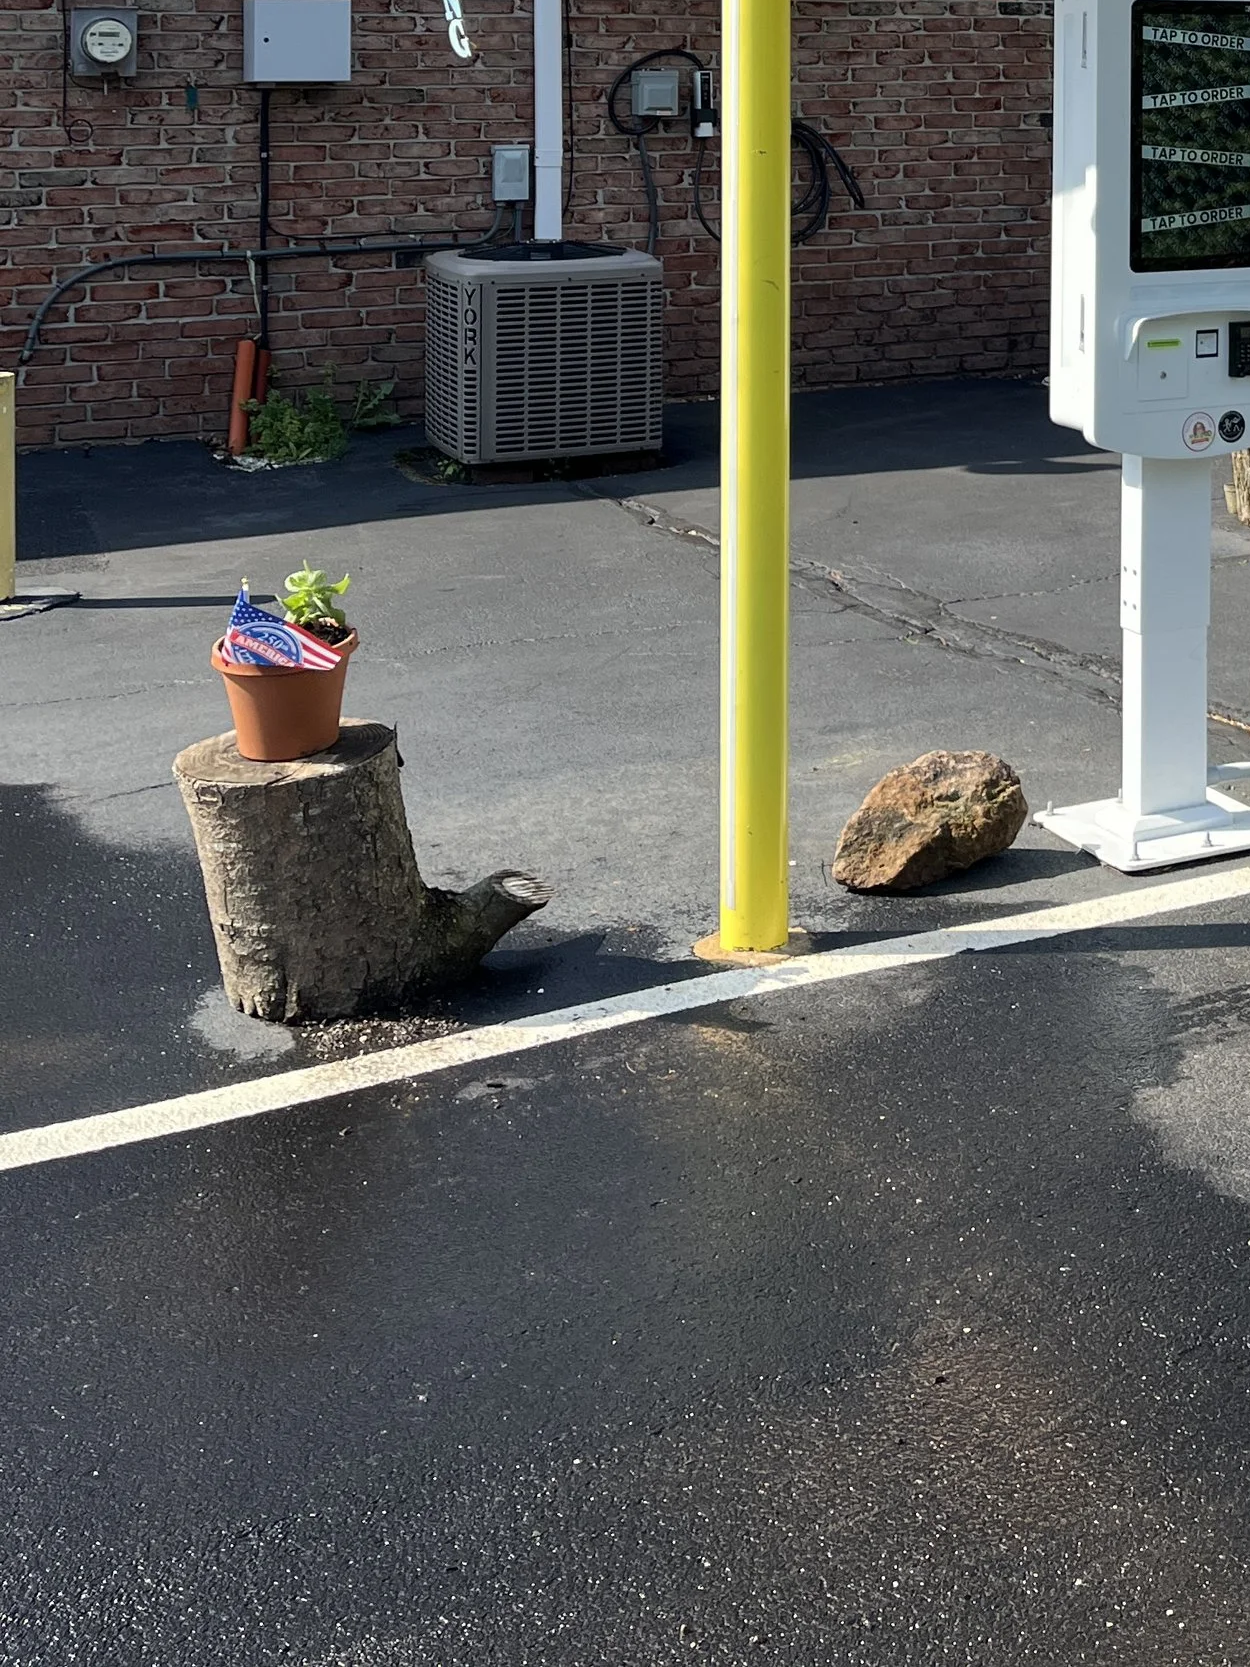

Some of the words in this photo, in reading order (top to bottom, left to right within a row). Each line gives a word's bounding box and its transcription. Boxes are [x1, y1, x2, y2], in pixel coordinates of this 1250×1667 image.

[1151, 27, 1178, 41] TAP
[1180, 31, 1198, 44] TO
[1201, 33, 1245, 49] ORDER
[1150, 93, 1177, 108] TAP
[1180, 92, 1198, 104] TO
[1200, 86, 1244, 102] ORDER
[1151, 146, 1177, 160] TAP
[1180, 149, 1197, 162] TO
[1200, 151, 1244, 166] ORDER
[1150, 215, 1176, 230] TAP
[1178, 213, 1197, 226] TO
[1200, 206, 1243, 223] ORDER
[464, 288, 477, 365] YORK
